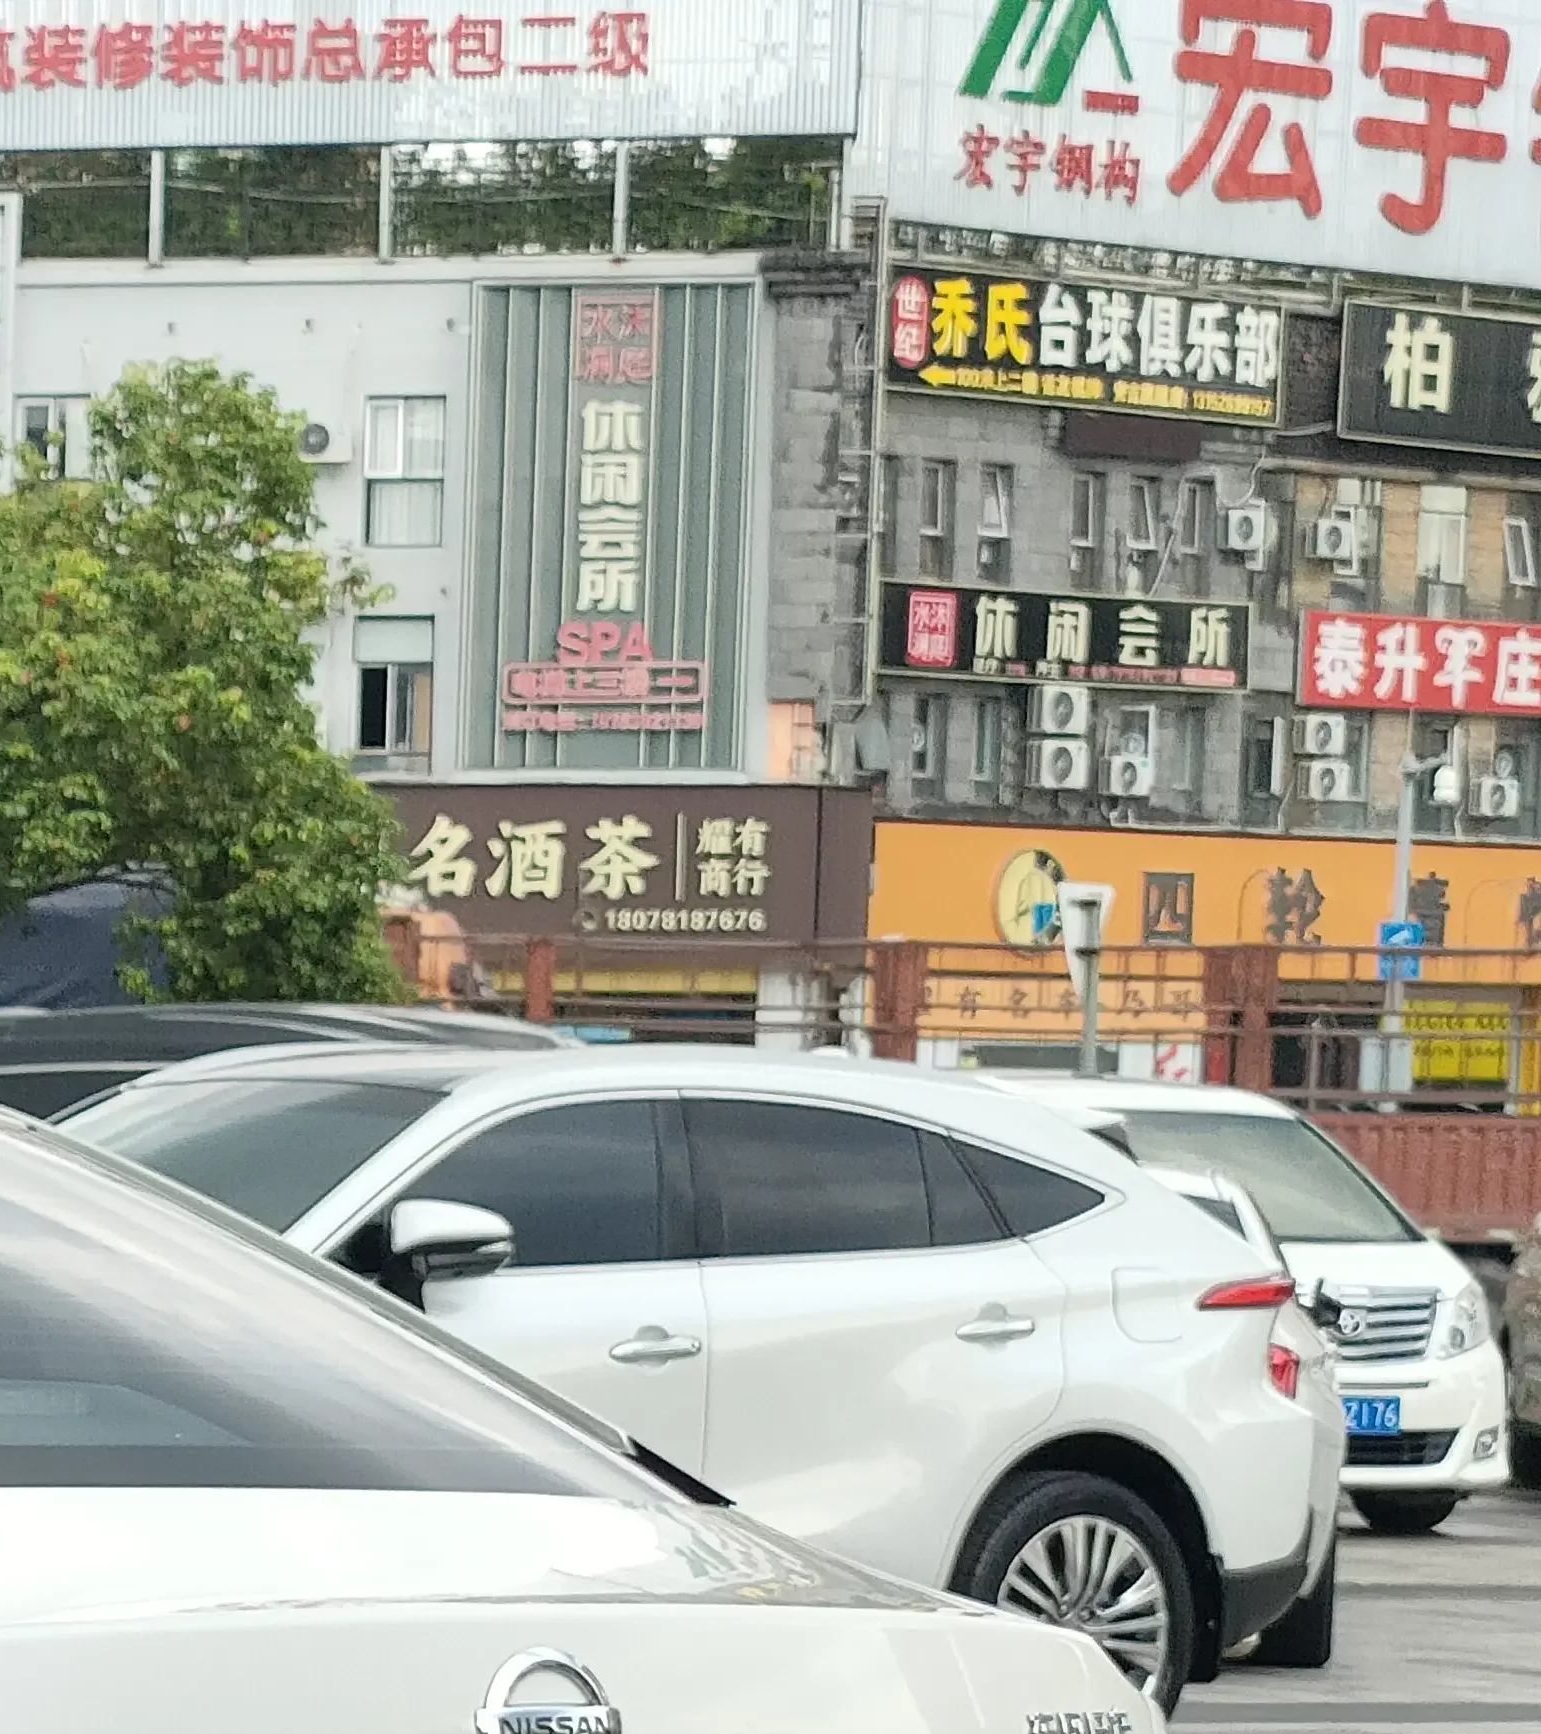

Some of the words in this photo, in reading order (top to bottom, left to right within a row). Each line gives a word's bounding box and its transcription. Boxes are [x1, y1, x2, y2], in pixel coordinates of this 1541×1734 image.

[953, 122, 1141, 208] 宏宇钢构
[930, 276, 1281, 389] 乔氏台球俱乐部
[575, 400, 645, 613] 休闲会所
[556, 620, 654, 664] SPA
[974, 595, 1232, 668] 休闲会所
[1312, 616, 1541, 710] 泰升羊庄
[407, 812, 660, 900] 名酒茶
[695, 858, 773, 898] 商行
[604, 907, 768, 932] 18078187676
